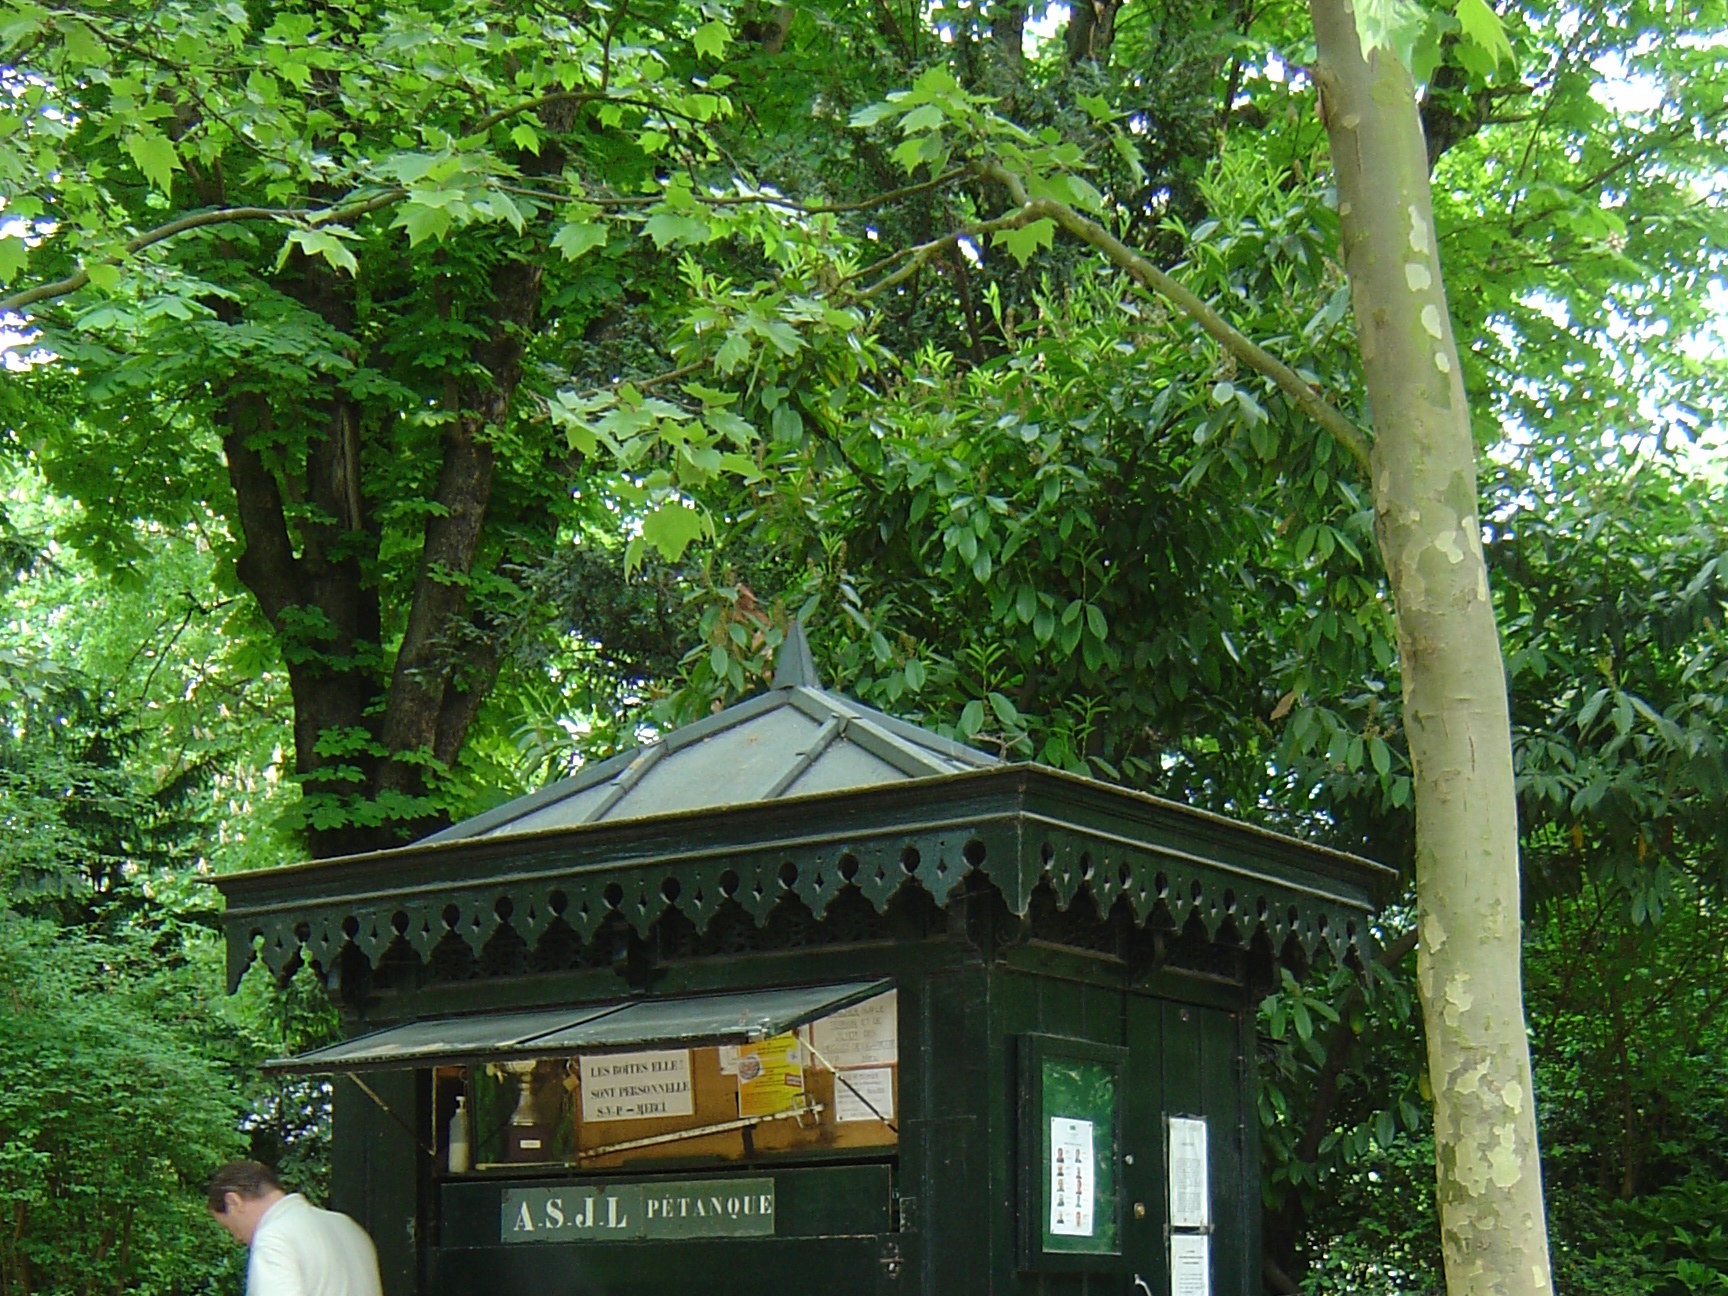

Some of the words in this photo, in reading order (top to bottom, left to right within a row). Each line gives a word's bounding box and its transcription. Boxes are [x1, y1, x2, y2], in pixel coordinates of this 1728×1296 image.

[590, 1066, 610, 1078] LES
[591, 1087, 615, 1099] SONT
[647, 1194, 772, 1219] PÉTANQUE
